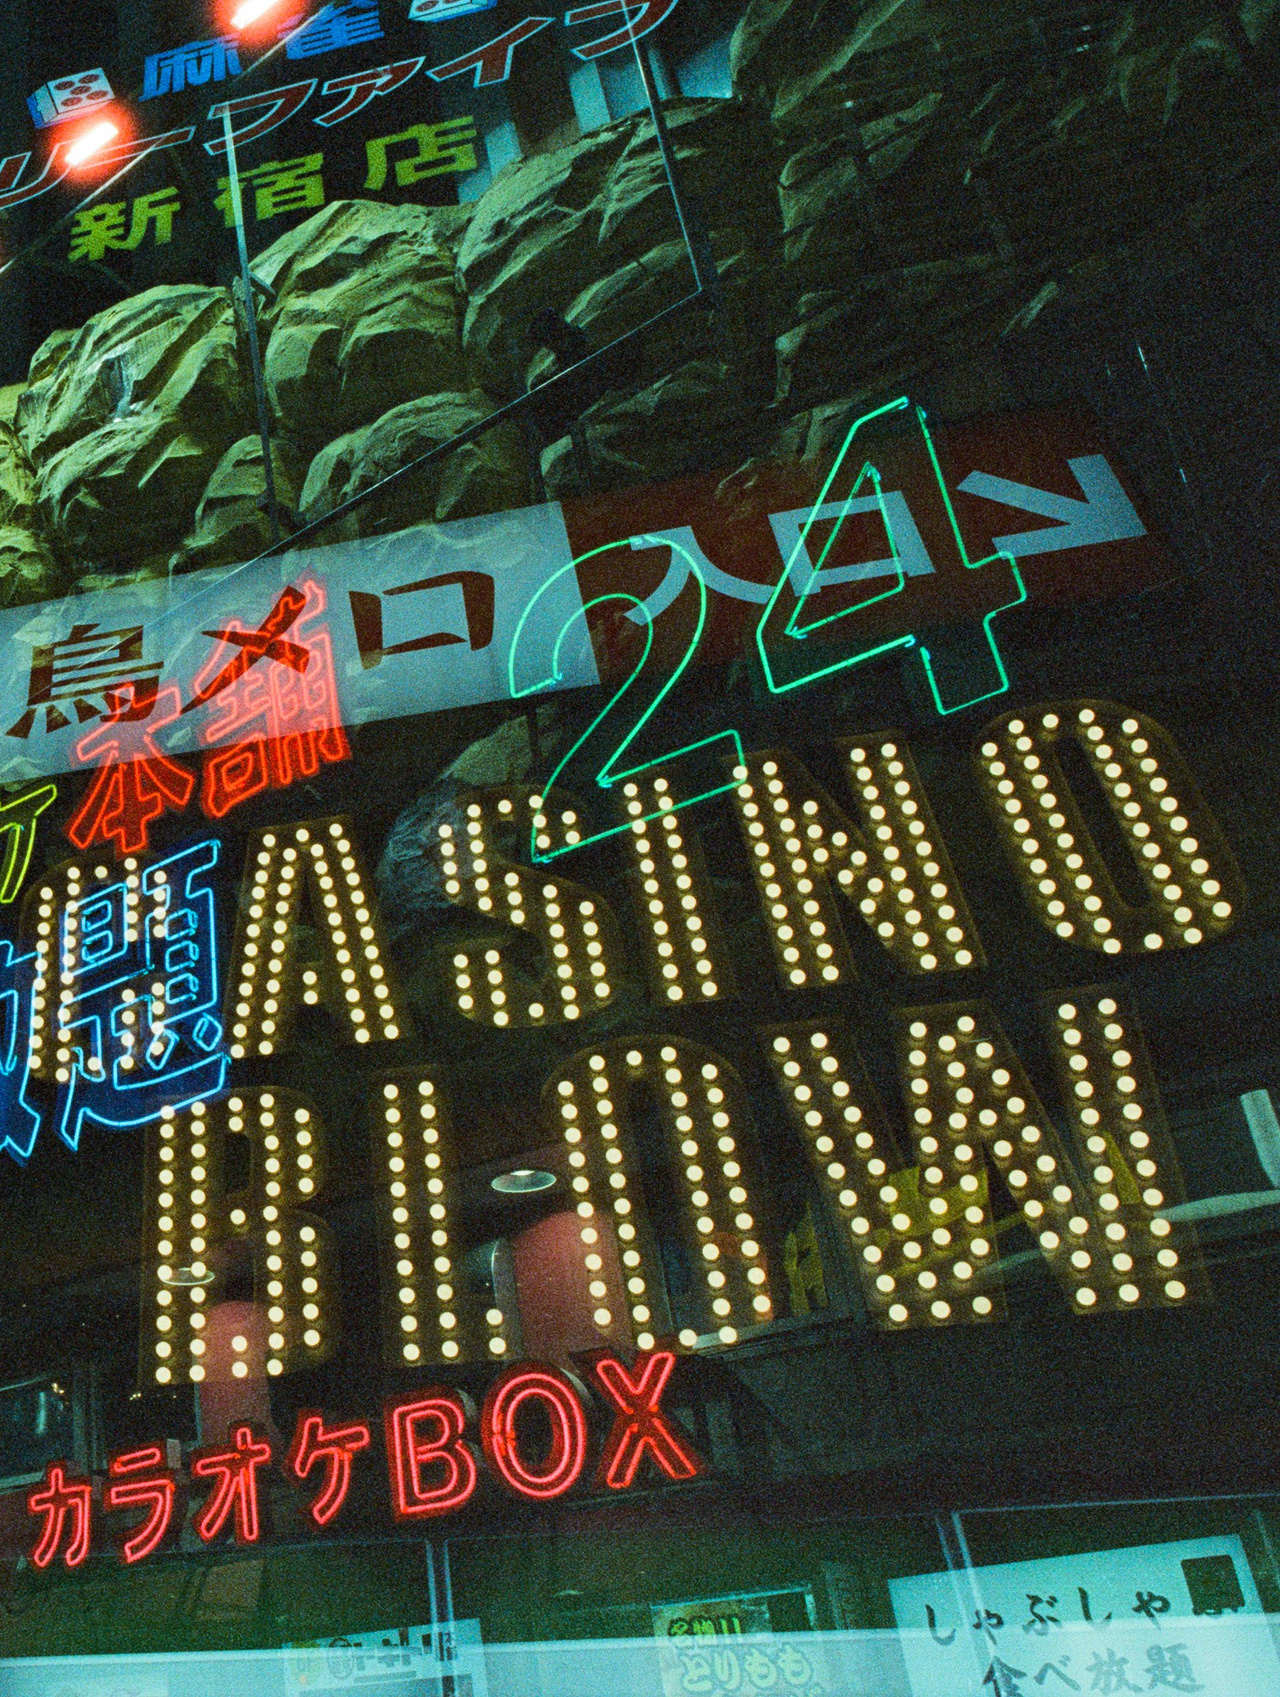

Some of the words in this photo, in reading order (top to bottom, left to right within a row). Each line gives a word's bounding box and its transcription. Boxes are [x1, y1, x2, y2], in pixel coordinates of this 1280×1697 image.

[68, 114, 481, 264] 新宿店
[510, 395, 1027, 865] 24
[623, 490, 936, 627] 入口
[23, 702, 1238, 1084] CASINO
[925, 1585, 1242, 1646] しゃぶしゃ
